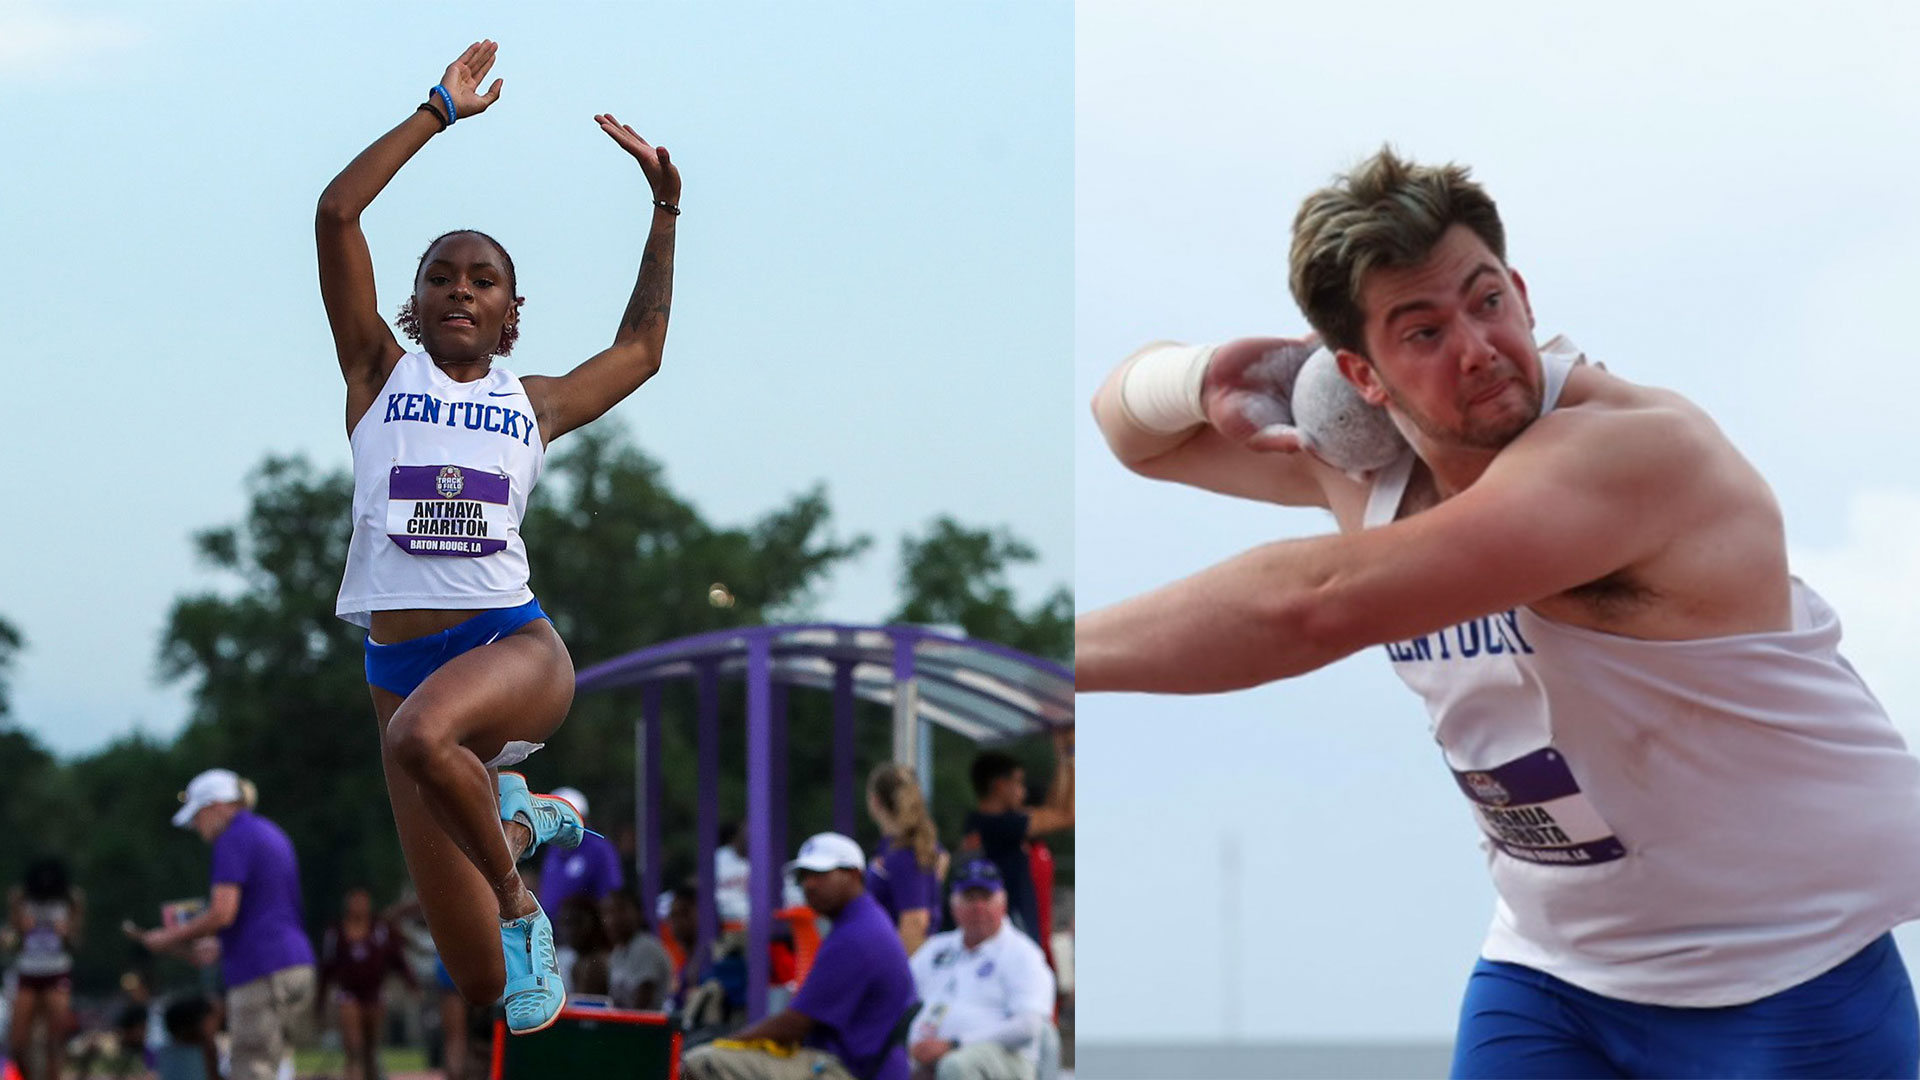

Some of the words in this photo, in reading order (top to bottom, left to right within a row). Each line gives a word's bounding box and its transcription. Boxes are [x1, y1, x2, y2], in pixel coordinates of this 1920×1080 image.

[383, 393, 534, 447] KENTUCKY
[414, 502, 483, 519] ANTHAYA
[407, 519, 488, 537] CHARLTON
[411, 540, 438, 550] BATON
[439, 540, 470, 553] ROUGE,
[470, 542, 482, 553] LA
